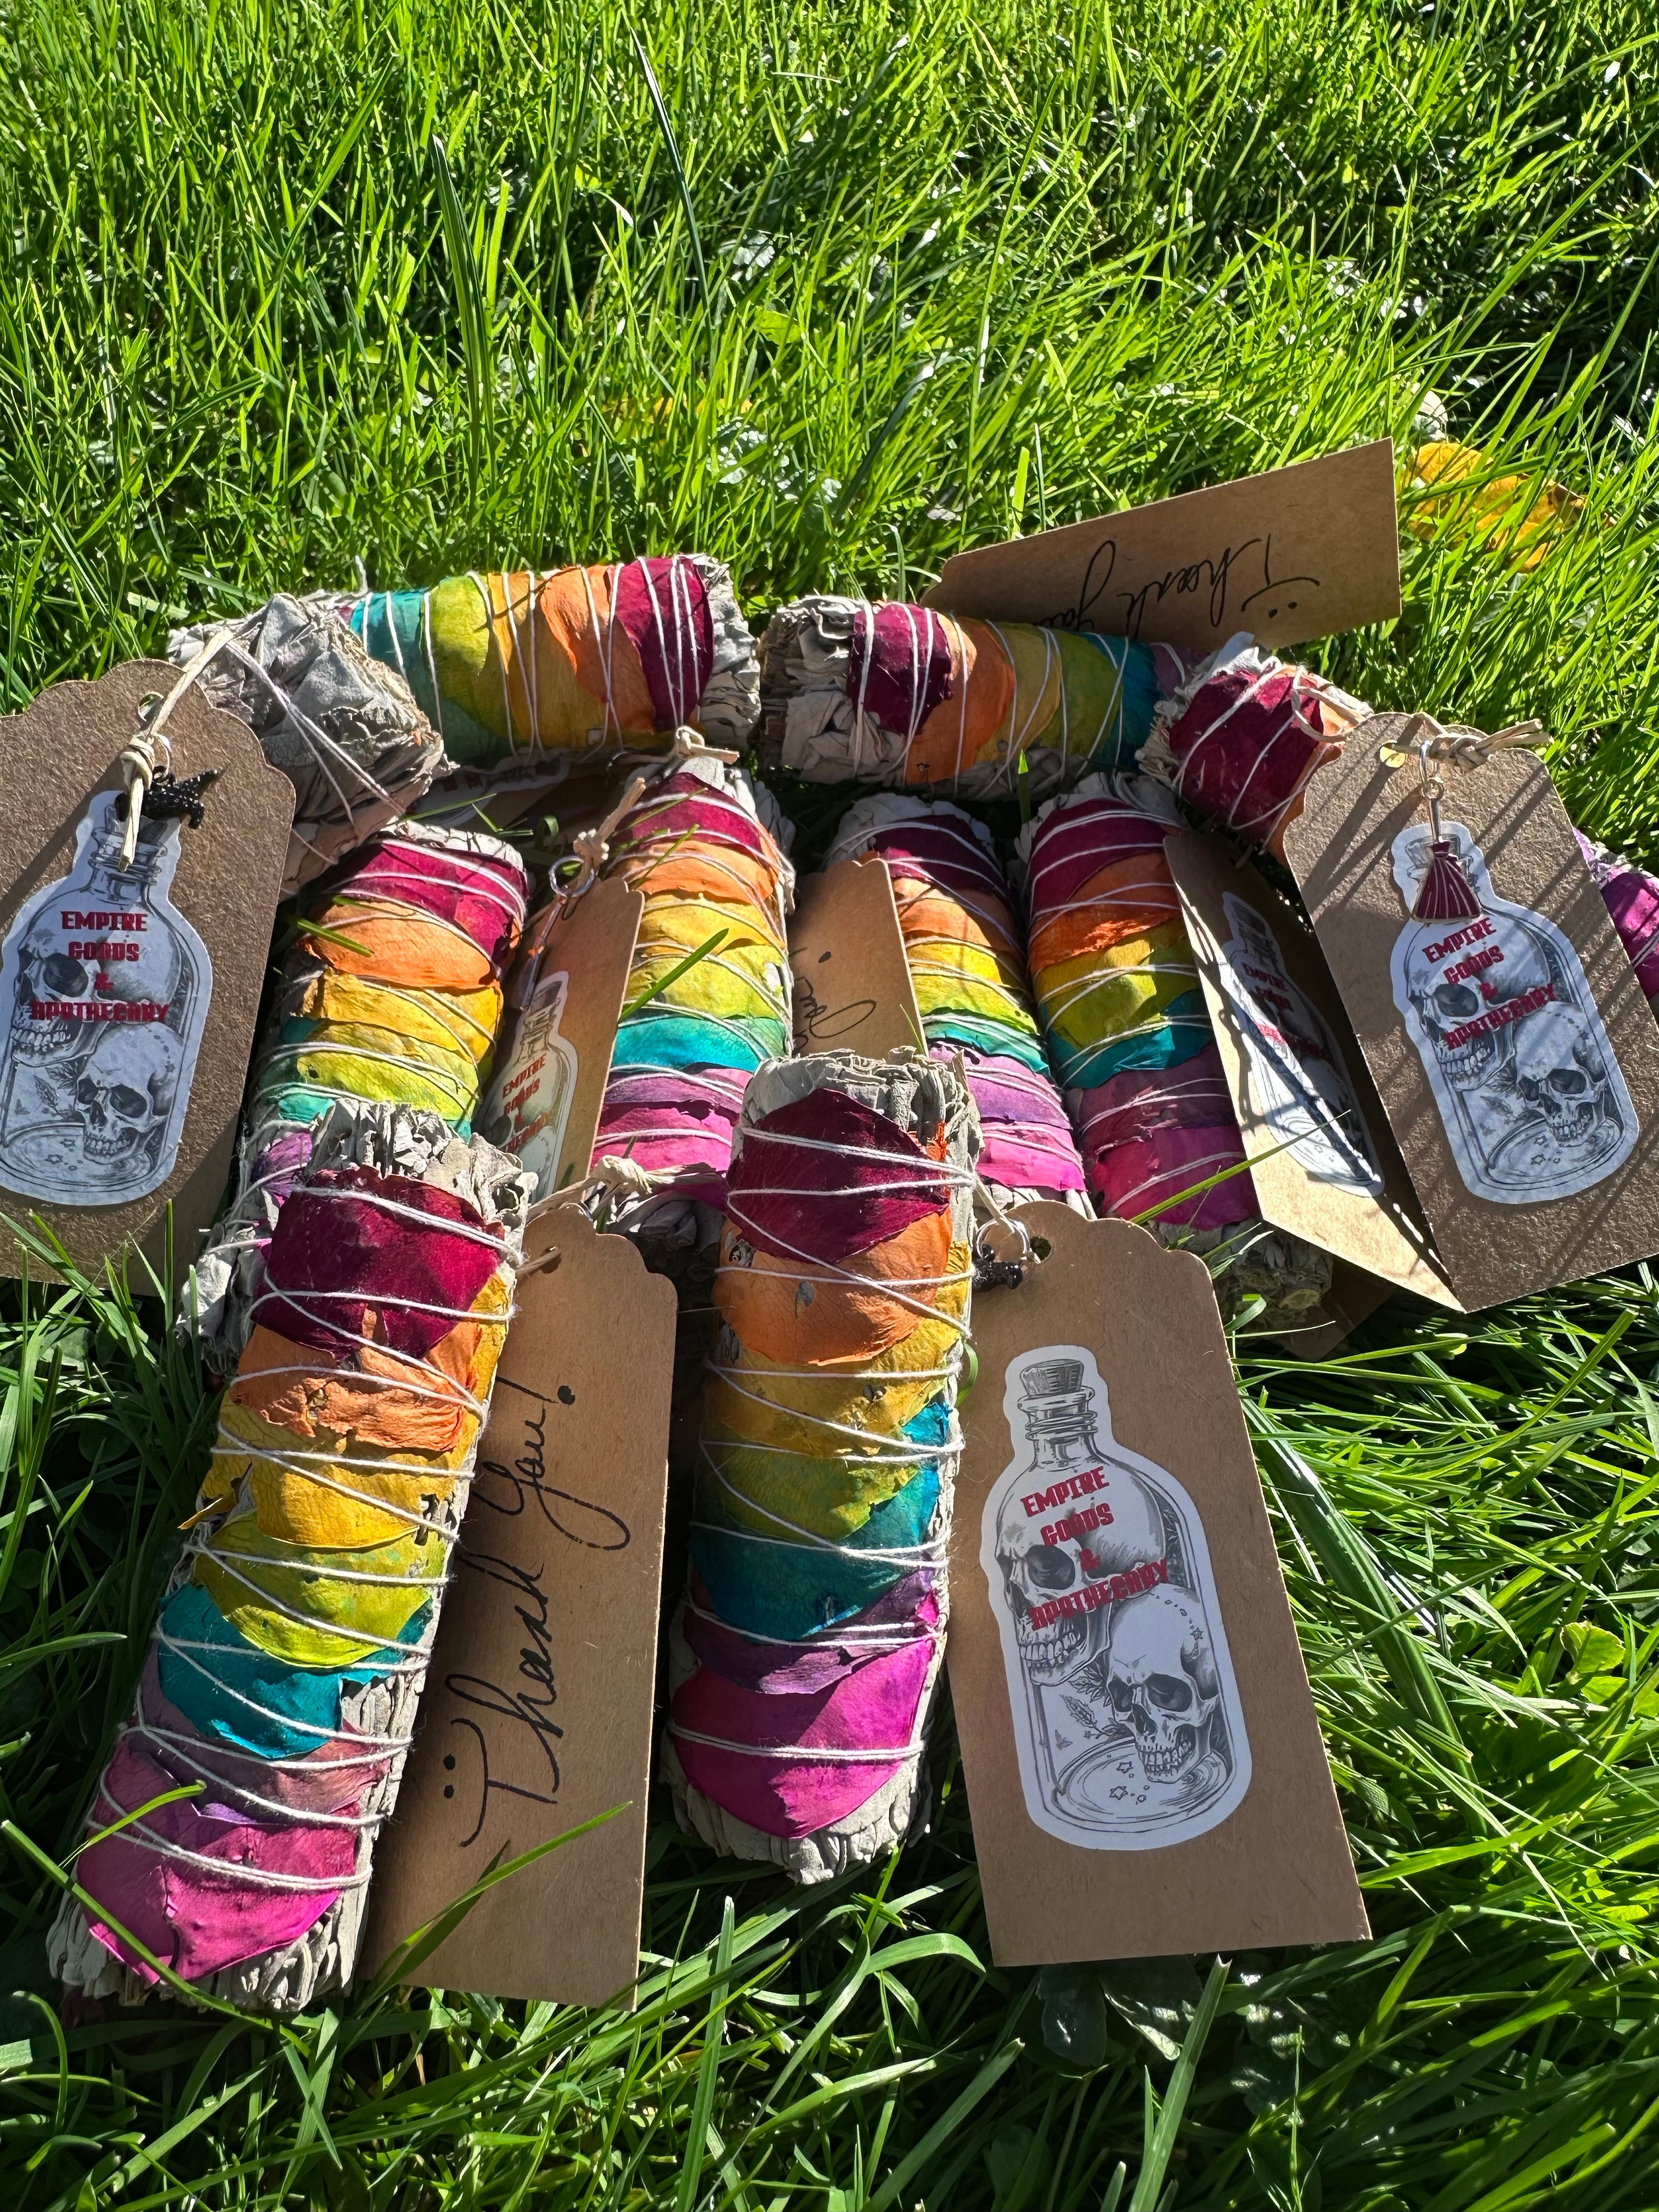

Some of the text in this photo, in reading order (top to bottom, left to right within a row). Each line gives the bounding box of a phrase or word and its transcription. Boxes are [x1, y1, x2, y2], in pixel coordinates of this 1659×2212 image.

[61, 911, 149, 932] EMPIRE
[1422, 917, 1497, 964] EMPIRE
[69, 941, 140, 962] GOODS
[1443, 945, 1505, 985] GOODS
[94, 971, 114, 991] &
[30, 1001, 170, 1023] APOTHECARY
[1443, 983, 1556, 1051] APOTHECARY
[503, 1053, 548, 1099] EMPIRE
[1020, 1466, 1110, 1518] EMPIRE
[1040, 1502, 1115, 1547] GOODS
[1079, 1548, 1101, 1572] &
[1029, 1558, 1169, 1632] APOTHECARY
